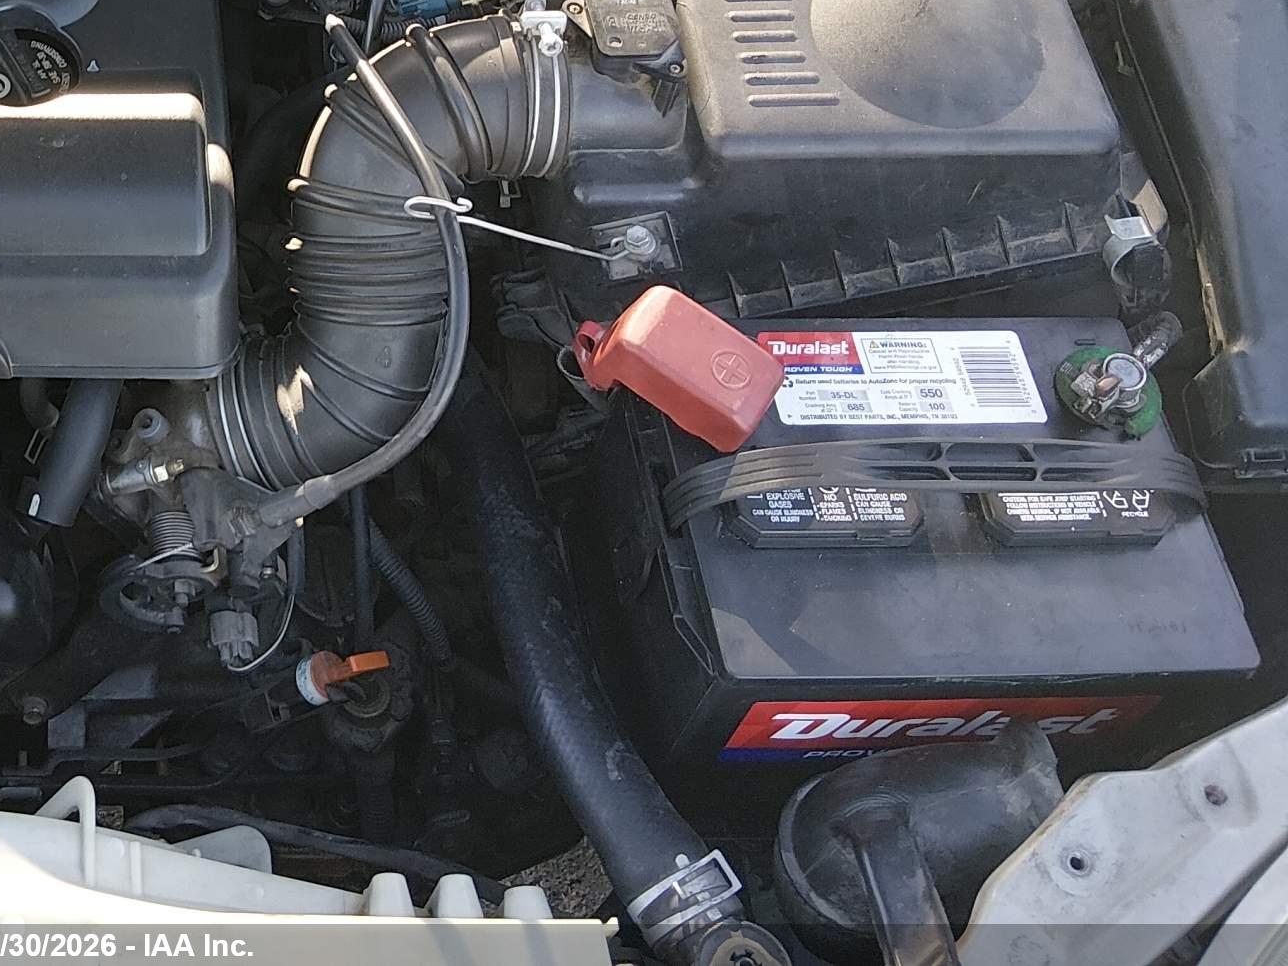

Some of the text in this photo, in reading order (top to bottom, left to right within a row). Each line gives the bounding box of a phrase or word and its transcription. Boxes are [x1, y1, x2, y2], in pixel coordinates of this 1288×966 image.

[767, 340, 850, 355] Duralast
[920, 388, 944, 398] 550
[928, 403, 946, 411] 100
[766, 492, 806, 501] EXPLOSIVE
[853, 493, 908, 501] SULFURIC ACID
[768, 500, 793, 509] GASES
[1121, 510, 1150, 518] RECYCLE
[803, 749, 874, 758] PRO
